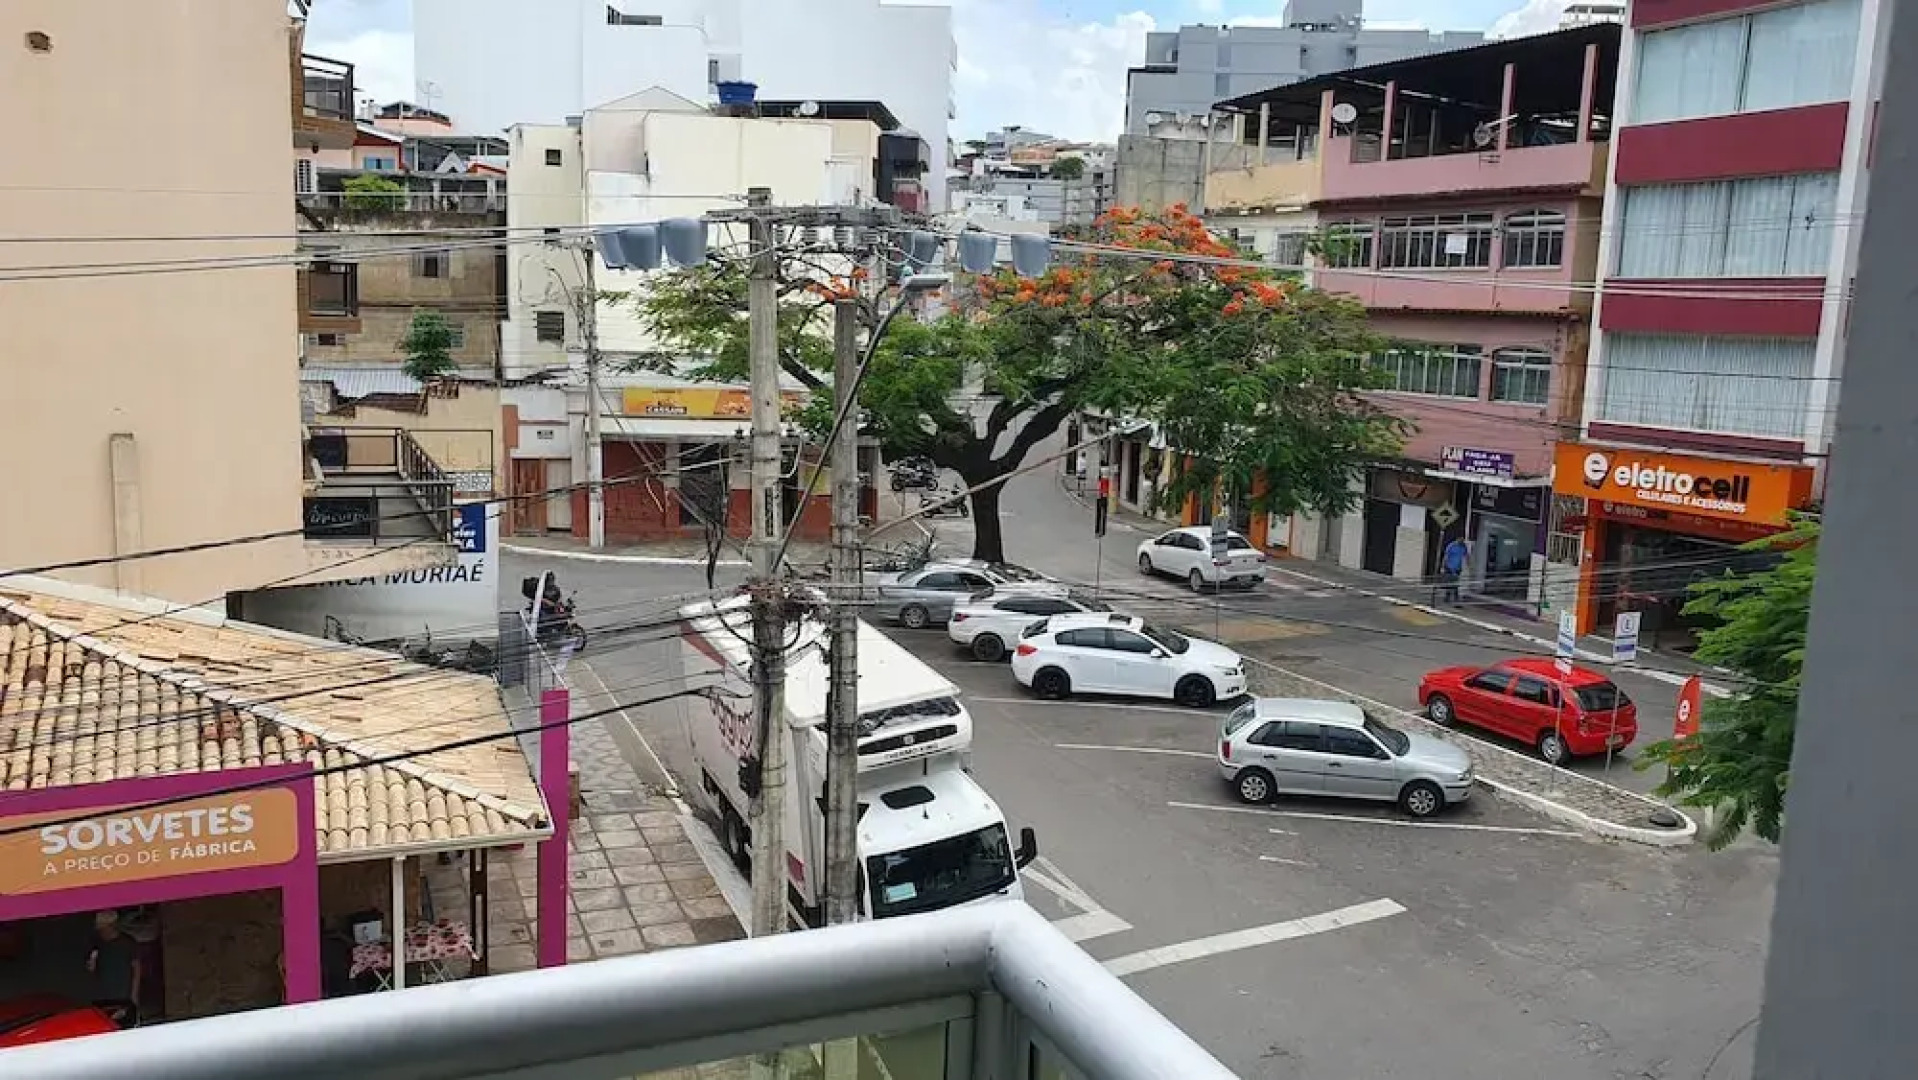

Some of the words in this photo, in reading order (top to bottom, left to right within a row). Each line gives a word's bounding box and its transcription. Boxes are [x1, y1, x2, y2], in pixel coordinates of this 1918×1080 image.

[1614, 462, 1750, 503] eletrocell
[40, 804, 254, 855] SORVETES
[43, 862, 58, 876] A
[64, 853, 131, 872] PREÇO
[137, 850, 162, 865] DE
[170, 840, 256, 861] FÁBRICA
